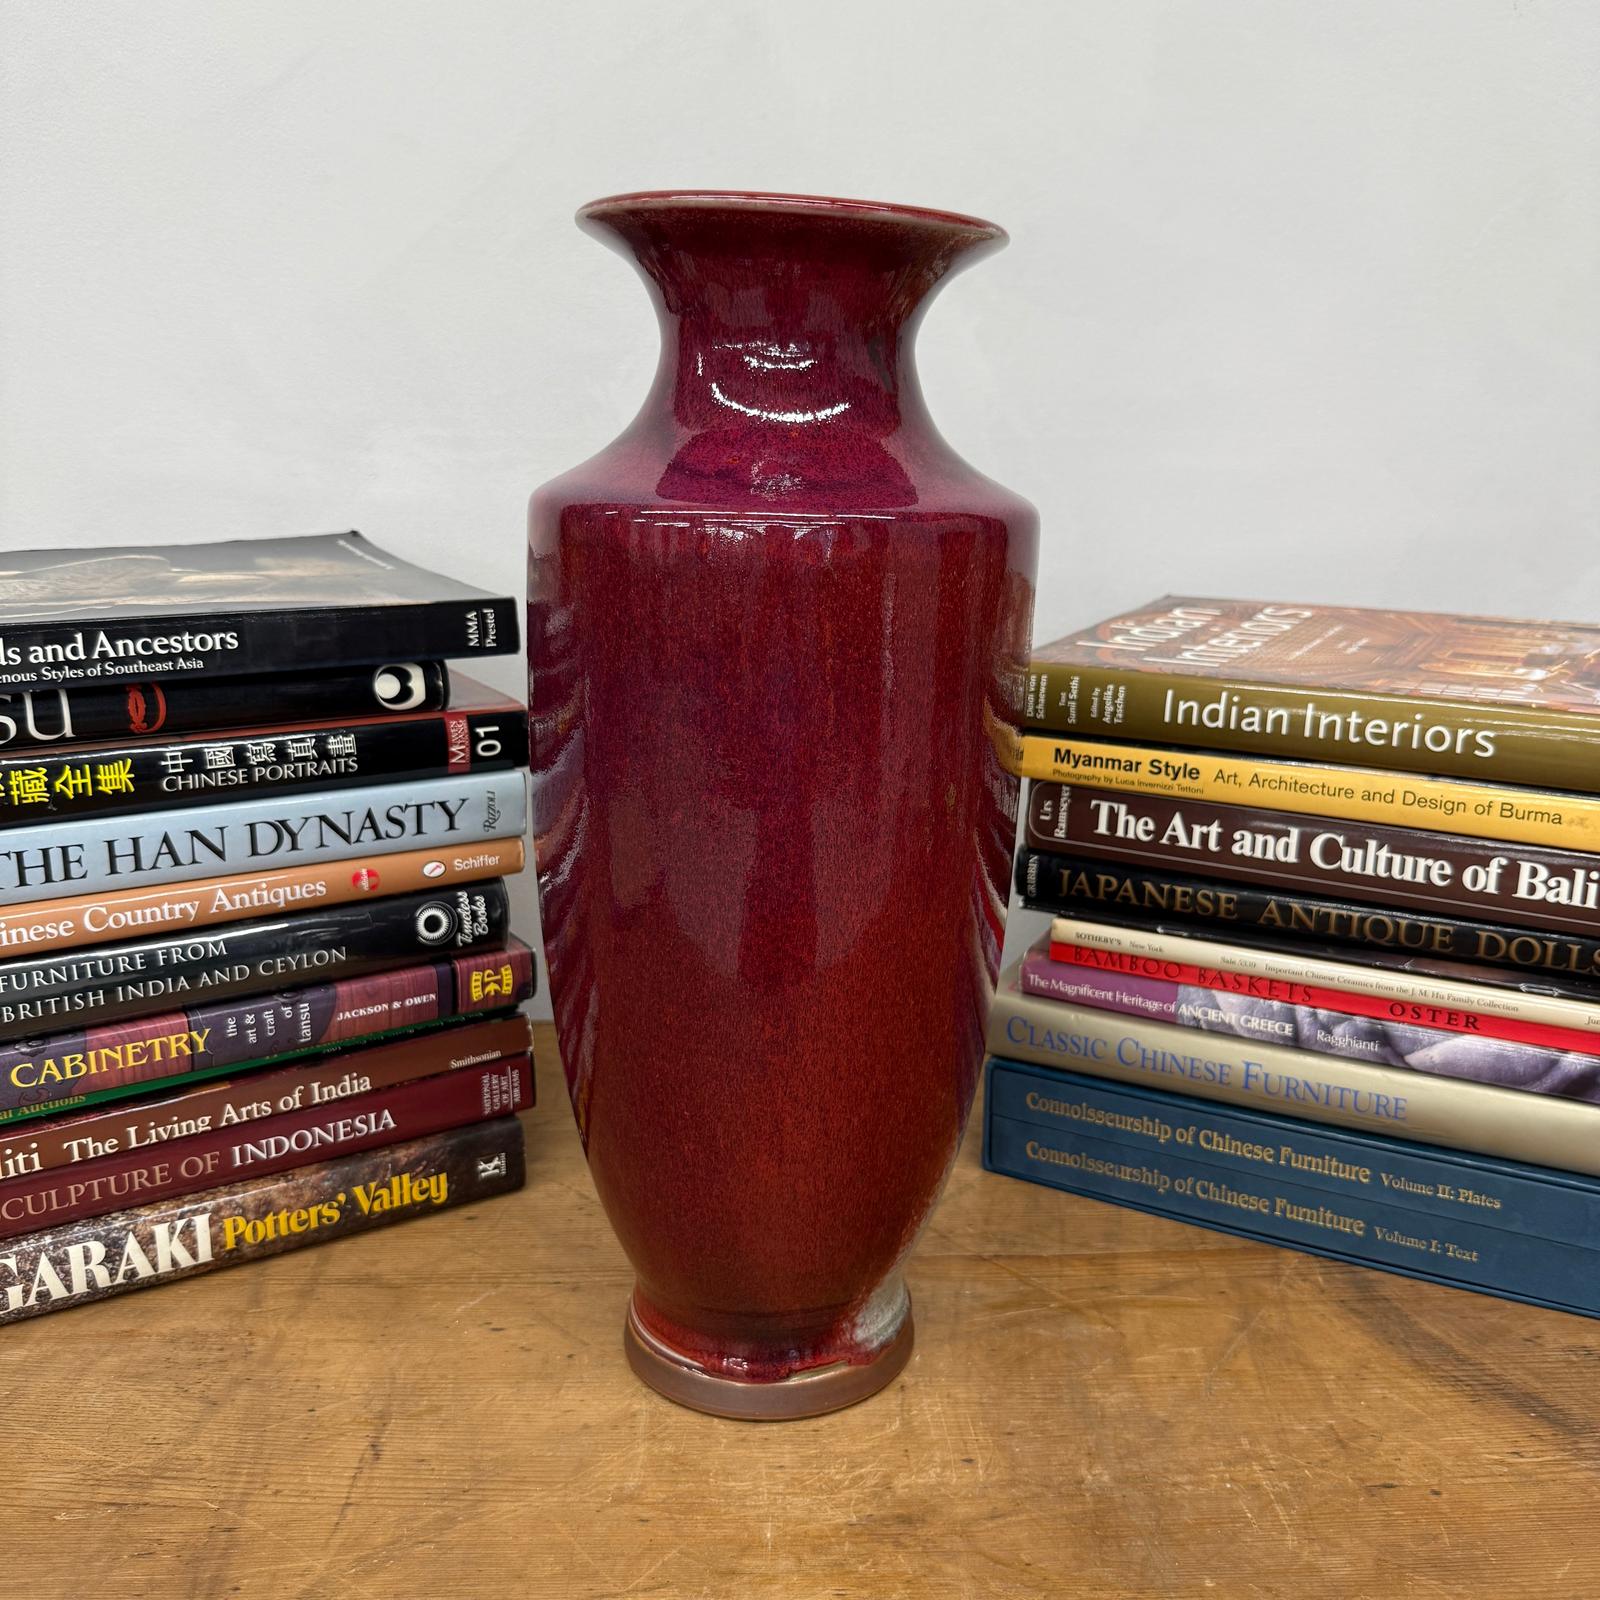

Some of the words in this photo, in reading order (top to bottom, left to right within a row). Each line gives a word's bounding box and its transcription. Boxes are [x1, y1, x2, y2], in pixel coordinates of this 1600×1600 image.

[465, 610, 480, 647] MMA
[482, 608, 497, 648] Prestel
[1076, 606, 1224, 652] Indian
[0, 637, 21, 666] s
[29, 633, 86, 664] and
[92, 631, 239, 659] Ancestors
[0, 672, 38, 684] nous
[41, 665, 84, 682] Styles
[87, 663, 102, 677] of
[106, 659, 173, 676] Southeast
[176, 657, 204, 670] Asia
[1028, 674, 1037, 691] von
[1069, 675, 1081, 700] Sethi
[1036, 674, 1048, 719] Schaewen
[1067, 701, 1078, 725] Sunil
[1102, 684, 1114, 723] Angelika
[1114, 686, 1126, 724] Taschen
[475, 725, 502, 757] 01
[1163, 688, 1290, 736] Indian
[1303, 702, 1497, 758] Interiors
[0, 758, 134, 806] 藏全集
[162, 768, 249, 792] CHINESE
[254, 757, 358, 782] PORTRAITS
[1052, 768, 1101, 783] Photography
[1103, 774, 1113, 786] by
[1115, 776, 1135, 786] Luca
[1137, 778, 1174, 792] Invernizzi
[1054, 747, 1141, 773] Myanmar
[1148, 759, 1200, 781] Style
[1039, 799, 1053, 821] Urs
[1054, 785, 1071, 839] Ramseyer
[1213, 768, 1242, 788] Art,
[1248, 772, 1354, 799] Architecture
[1361, 788, 1395, 804] and
[1402, 790, 1467, 815] Design
[1474, 801, 1494, 815] of
[1500, 802, 1562, 825] Burma
[103, 826, 229, 876] HAN
[244, 798, 469, 858] DYNASTY
[1090, 799, 1156, 842] The
[1159, 811, 1223, 852] Art
[1231, 826, 1300, 864] and
[1309, 832, 1453, 887] Culture
[1462, 856, 1508, 895] of
[1512, 860, 1599, 909] Bali
[453, 854, 501, 872] Schiffer
[1027, 854, 1040, 898] GRIBBIN
[83, 900, 200, 933] Country
[209, 880, 327, 914] Antiques
[456, 889, 473, 948] Timeless
[472, 894, 489, 936] Books
[1058, 869, 1238, 919] JAPANESE
[1257, 900, 1455, 951] ANTIQUE
[0, 952, 147, 993] FURNITURE
[157, 940, 228, 966] FROM
[2, 989, 106, 1023] BRITISH
[117, 975, 190, 1002] INDIA
[199, 964, 250, 988] AND
[258, 946, 348, 976] CEYLON
[1073, 945, 1183, 979] BAMBOO
[1197, 967, 1311, 1002] BASKETS
[1075, 930, 1122, 946] SOTHEBY'S
[1129, 940, 1145, 950] New
[1146, 941, 1164, 953] York
[1265, 963, 1303, 977] Important
[1305, 969, 1335, 982] Chinese
[1337, 974, 1375, 988] Ceramics
[1376, 980, 1395, 993] from
[1396, 984, 1409, 995] the
[1446, 992, 1475, 1007] Family
[1476, 996, 1519, 1011] Collection
[244, 1013, 256, 1025] &
[262, 1009, 275, 1036] craft
[280, 1005, 293, 1019] of
[298, 1002, 312, 1043] tansu
[336, 1002, 389, 1021] JACKSON
[392, 1000, 402, 1010] &
[405, 992, 437, 1007] OWEN
[1027, 974, 1049, 989] The
[1050, 979, 1114, 1002] Magnificent
[1115, 991, 1163, 1012] Heritage
[1163, 1000, 1177, 1013] of
[1177, 1003, 1241, 1027] ANCIENT
[1241, 1014, 1294, 1036] GREECE
[1389, 1002, 1480, 1031] OSTER
[225, 1016, 238, 1037] the
[244, 1026, 256, 1044] art
[1316, 1029, 1380, 1052] Ragghianti
[10, 1028, 211, 1088] CABINETRY
[450, 1049, 502, 1069] Smithsonian
[1006, 1016, 1108, 1060] CLASSIC
[1116, 1037, 1233, 1085] CHINESE
[1241, 1060, 1407, 1121] FURNITURE
[0, 1142, 43, 1179] iti
[62, 1136, 119, 1164] The
[127, 1116, 212, 1148] Living
[219, 1100, 273, 1127] Arts
[279, 1085, 305, 1111] of
[311, 1072, 372, 1104] India
[1026, 1092, 1171, 1143] Connoisseurship
[1175, 1126, 1196, 1144] of
[1199, 1130, 1274, 1162] Chinese
[1279, 1146, 1370, 1184] Furniture
[0, 1163, 173, 1220] CULPTURE
[180, 1151, 220, 1178] OF
[231, 1108, 397, 1168] INDONESIA
[352, 1172, 449, 1216] Valley
[1026, 1141, 1170, 1194] Connoisseurship
[1174, 1176, 1194, 1195] of
[1195, 1180, 1269, 1213] Chinese
[1274, 1197, 1366, 1236] Furniture
[1380, 1172, 1433, 1195] Volume
[1436, 1184, 1454, 1200] II:
[1458, 1188, 1502, 1210] Plates
[1374, 1226, 1427, 1250] Volume
[1445, 1242, 1479, 1262] Text
